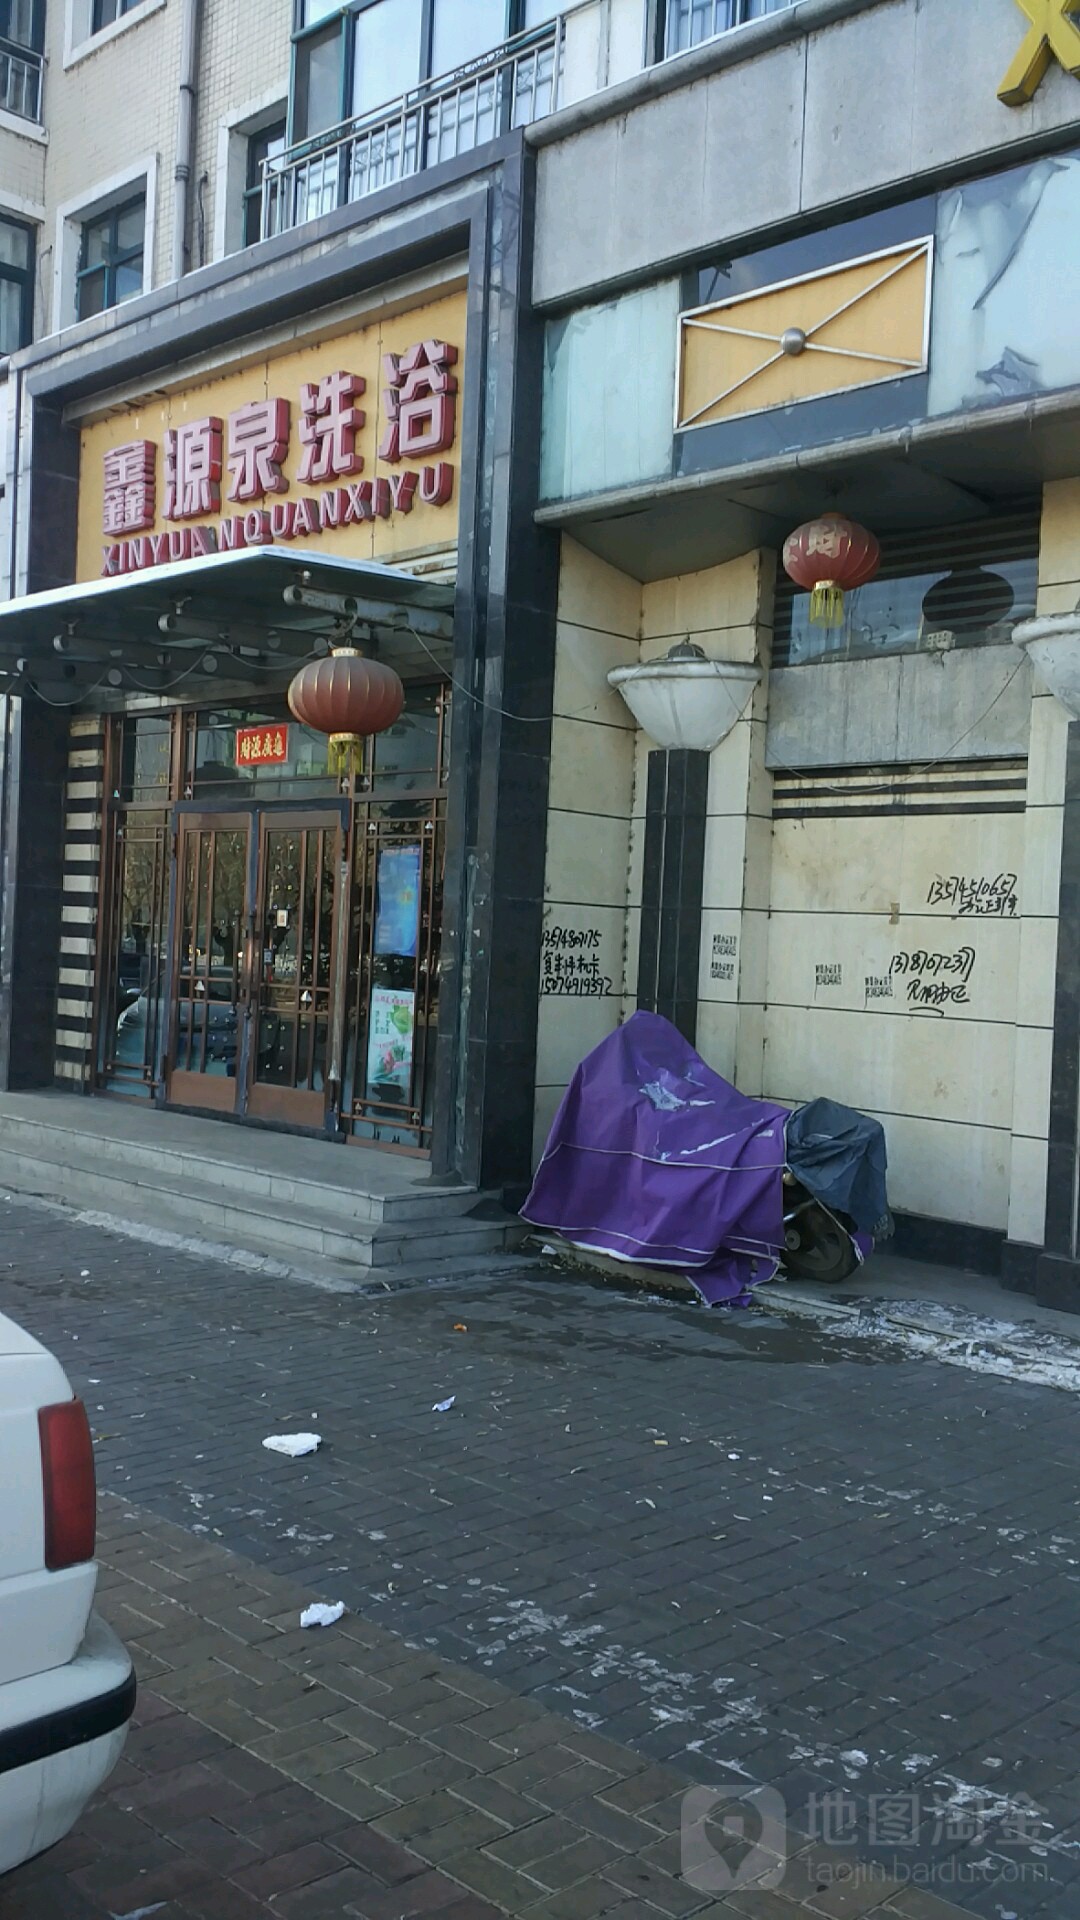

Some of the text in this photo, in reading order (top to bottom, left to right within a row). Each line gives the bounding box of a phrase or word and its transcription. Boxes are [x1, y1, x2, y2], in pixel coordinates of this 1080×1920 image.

[103, 339, 457, 538] 鑫源泉洗浴
